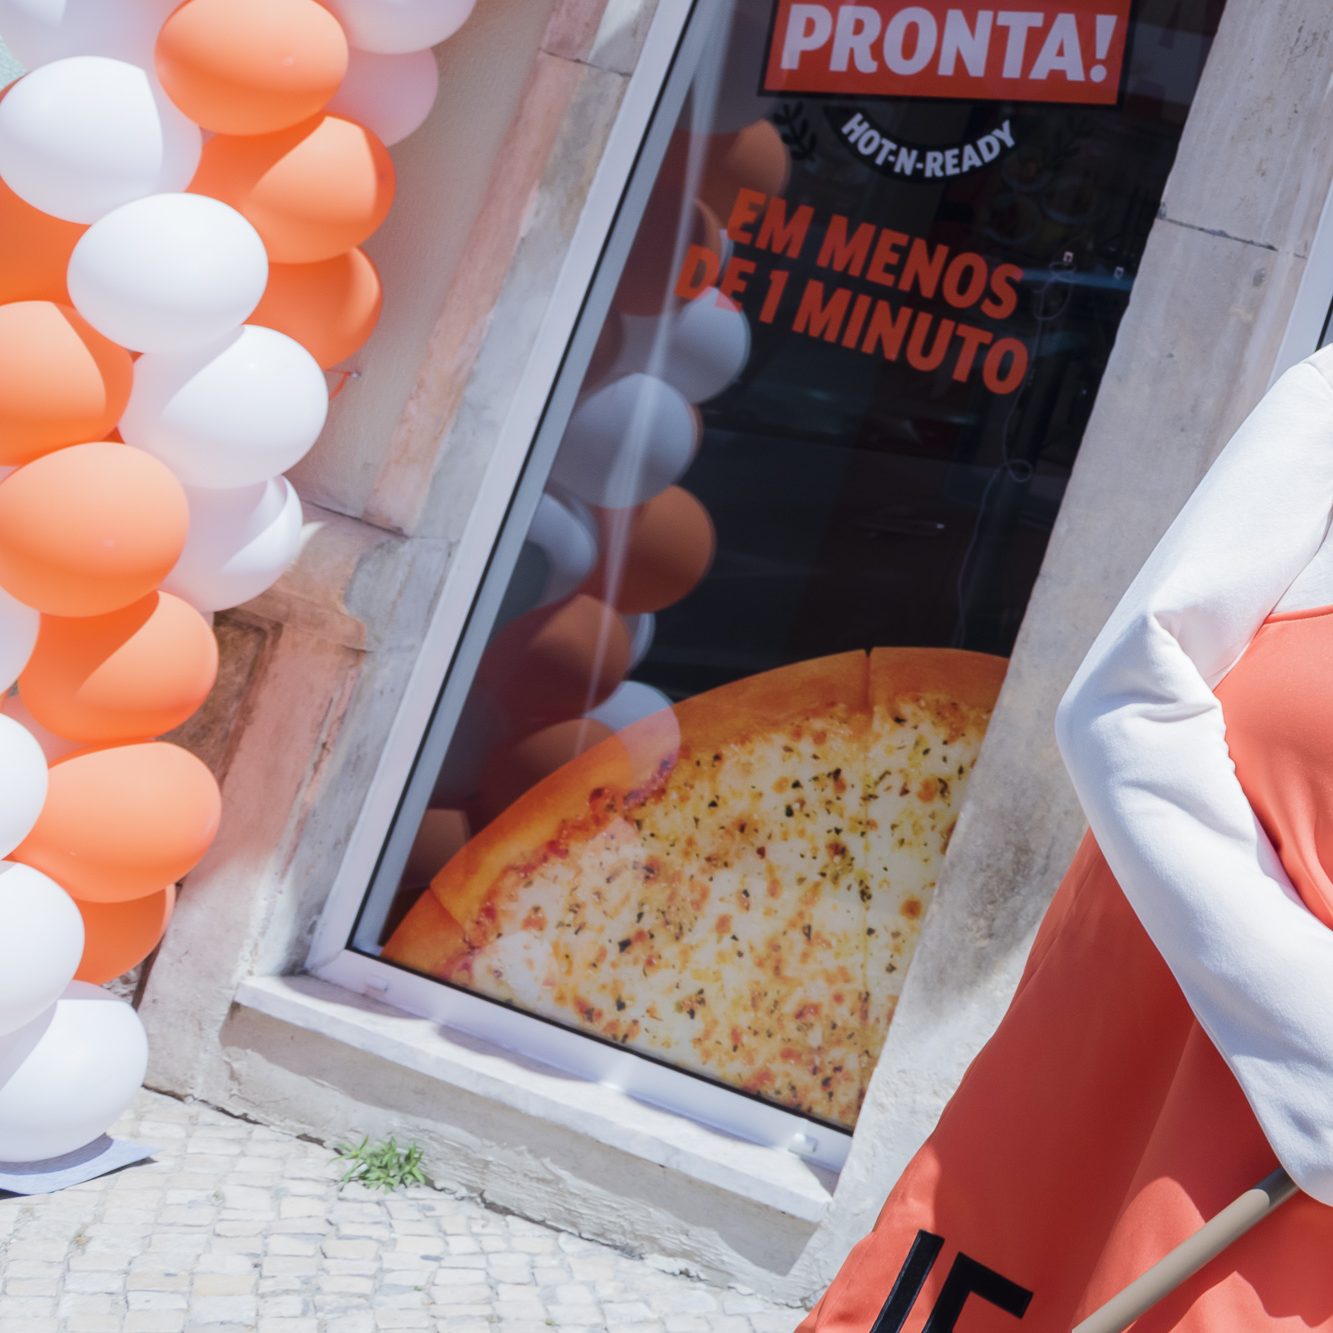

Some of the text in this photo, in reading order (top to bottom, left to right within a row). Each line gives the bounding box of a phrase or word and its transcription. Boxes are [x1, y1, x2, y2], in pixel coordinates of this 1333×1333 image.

[779, 3, 1118, 83] PRONTA!
[840, 112, 1017, 179] HOT-N-READY
[726, 187, 1025, 321] EM MENOS
[674, 243, 1030, 395] DE 1 MINUTO
